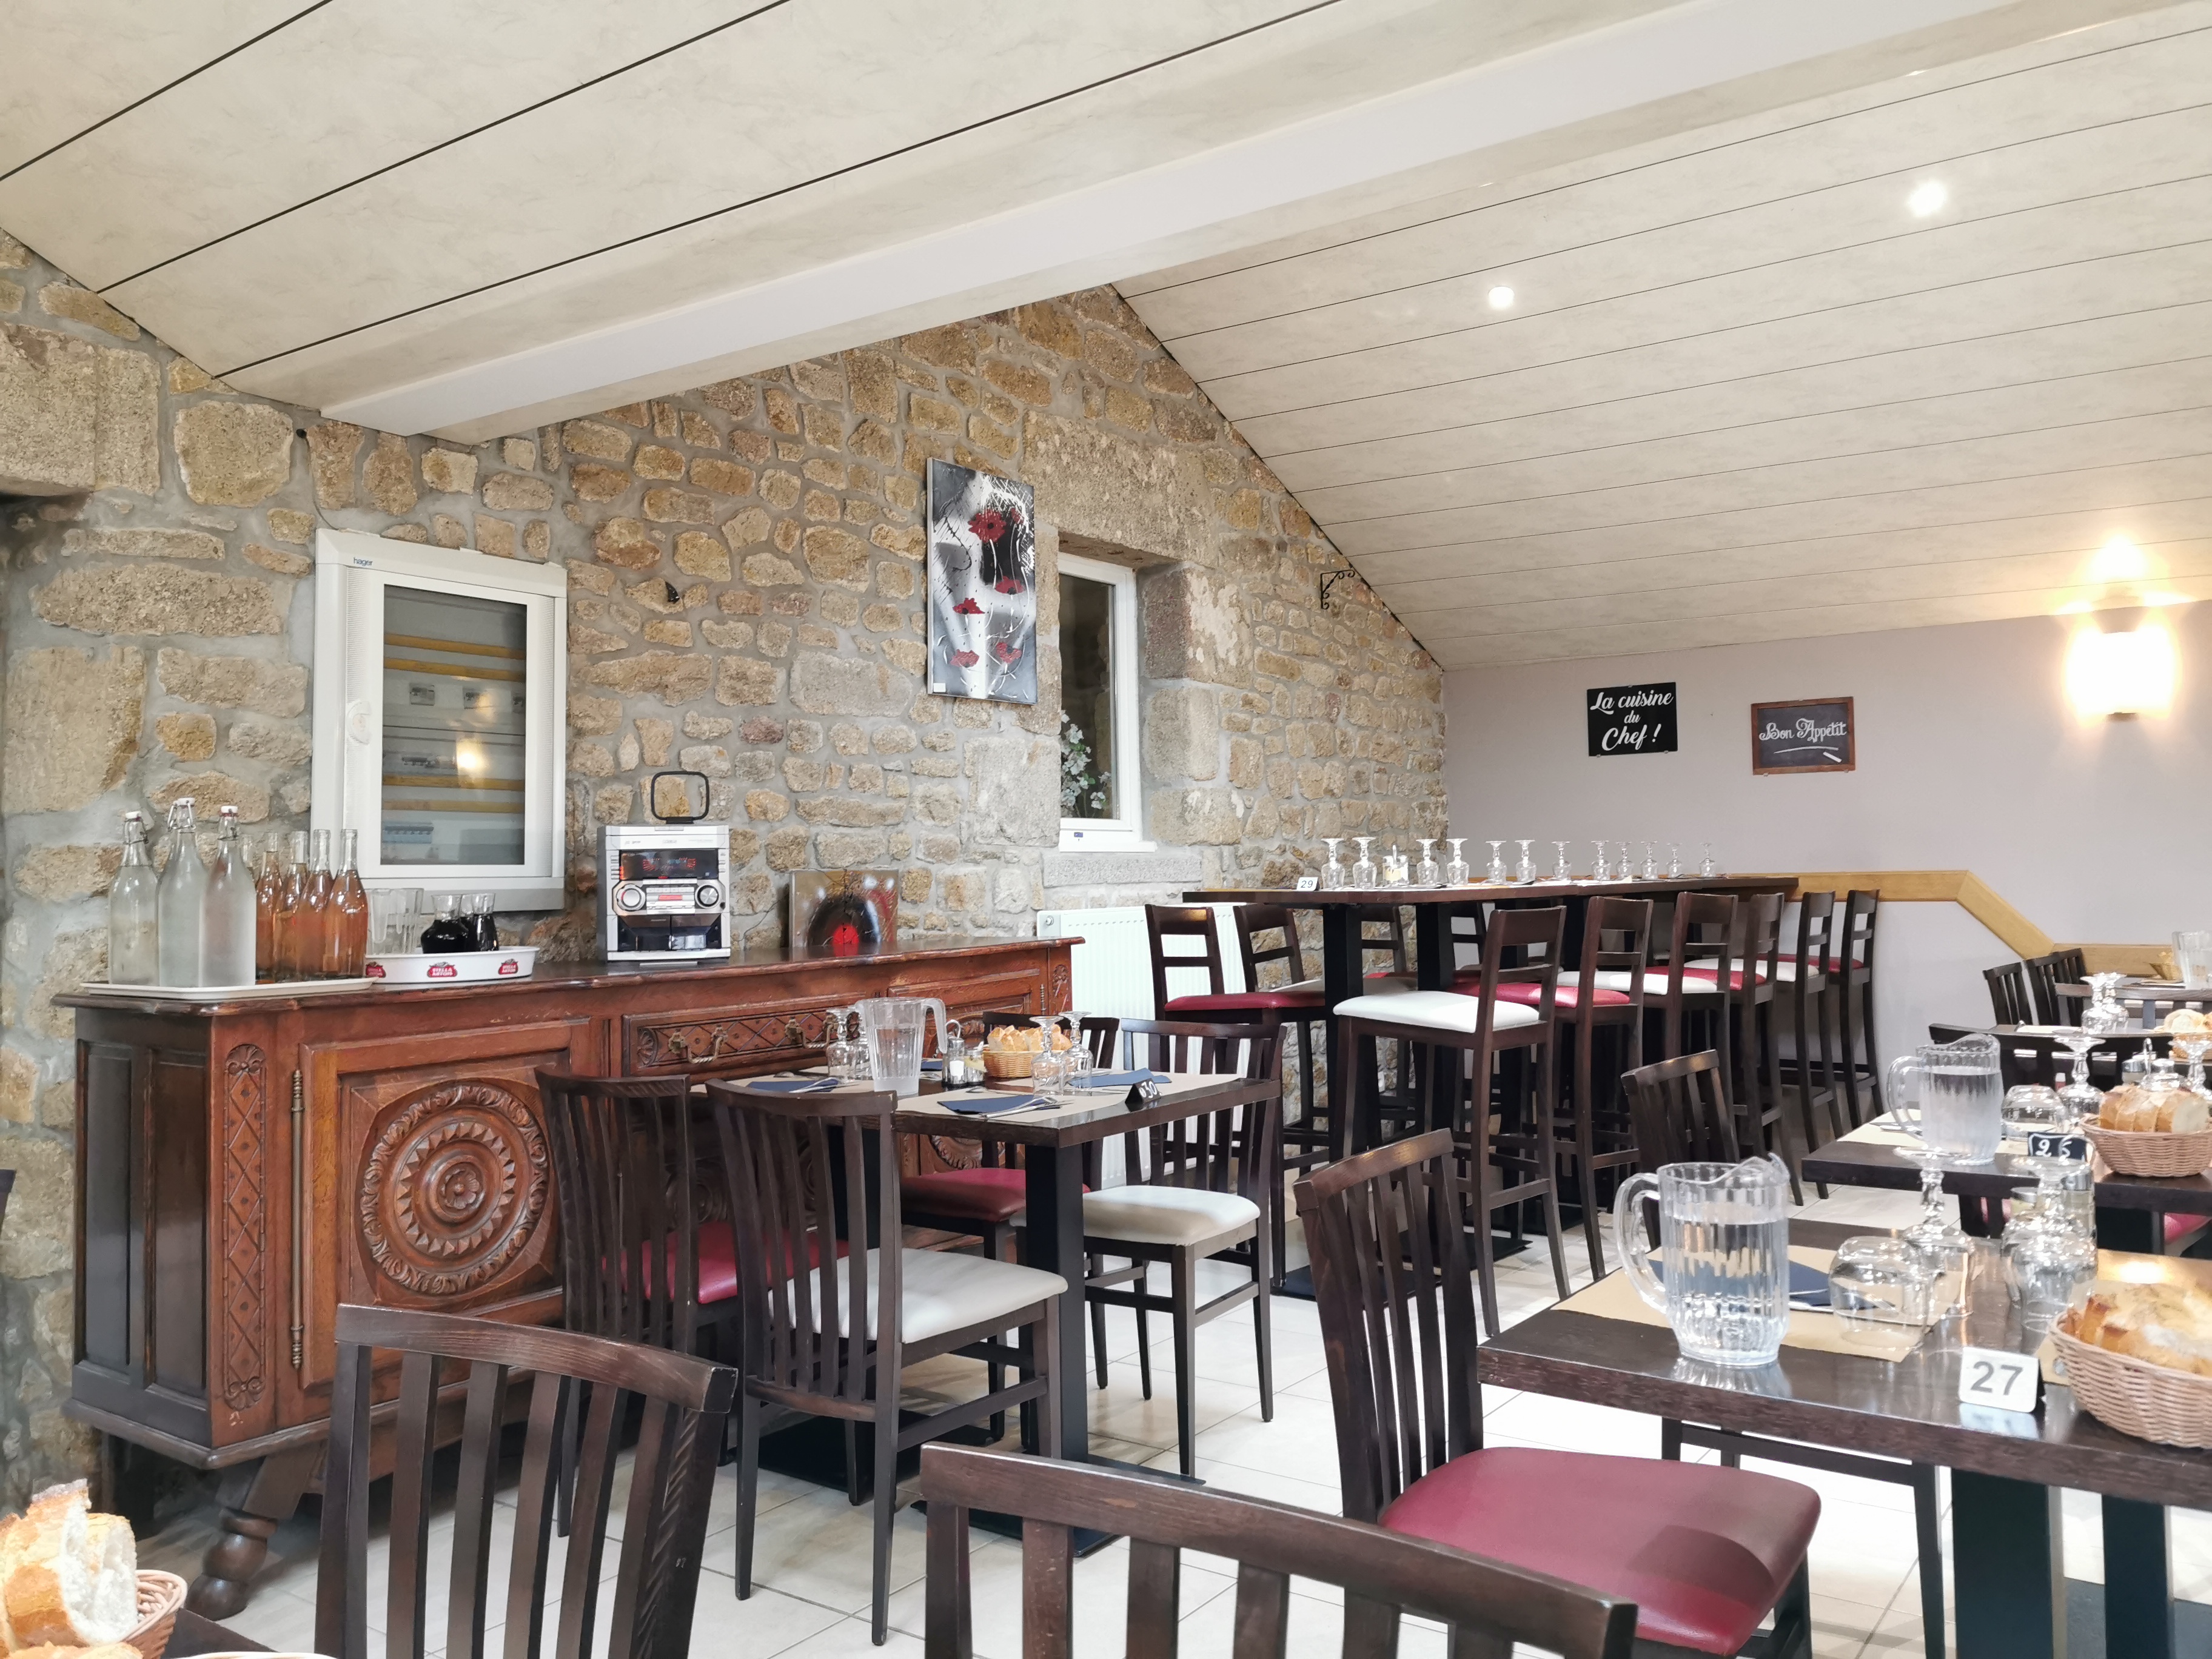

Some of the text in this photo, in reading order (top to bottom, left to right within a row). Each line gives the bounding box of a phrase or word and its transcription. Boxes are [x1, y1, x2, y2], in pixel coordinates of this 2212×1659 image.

[354, 557, 373, 566] hager
[1590, 689, 1674, 715] La cuisine
[1624, 710, 1640, 723] du
[1759, 722, 1795, 741] Bon
[1300, 880, 1313, 888] 29
[1970, 1361, 2023, 1396] 27
